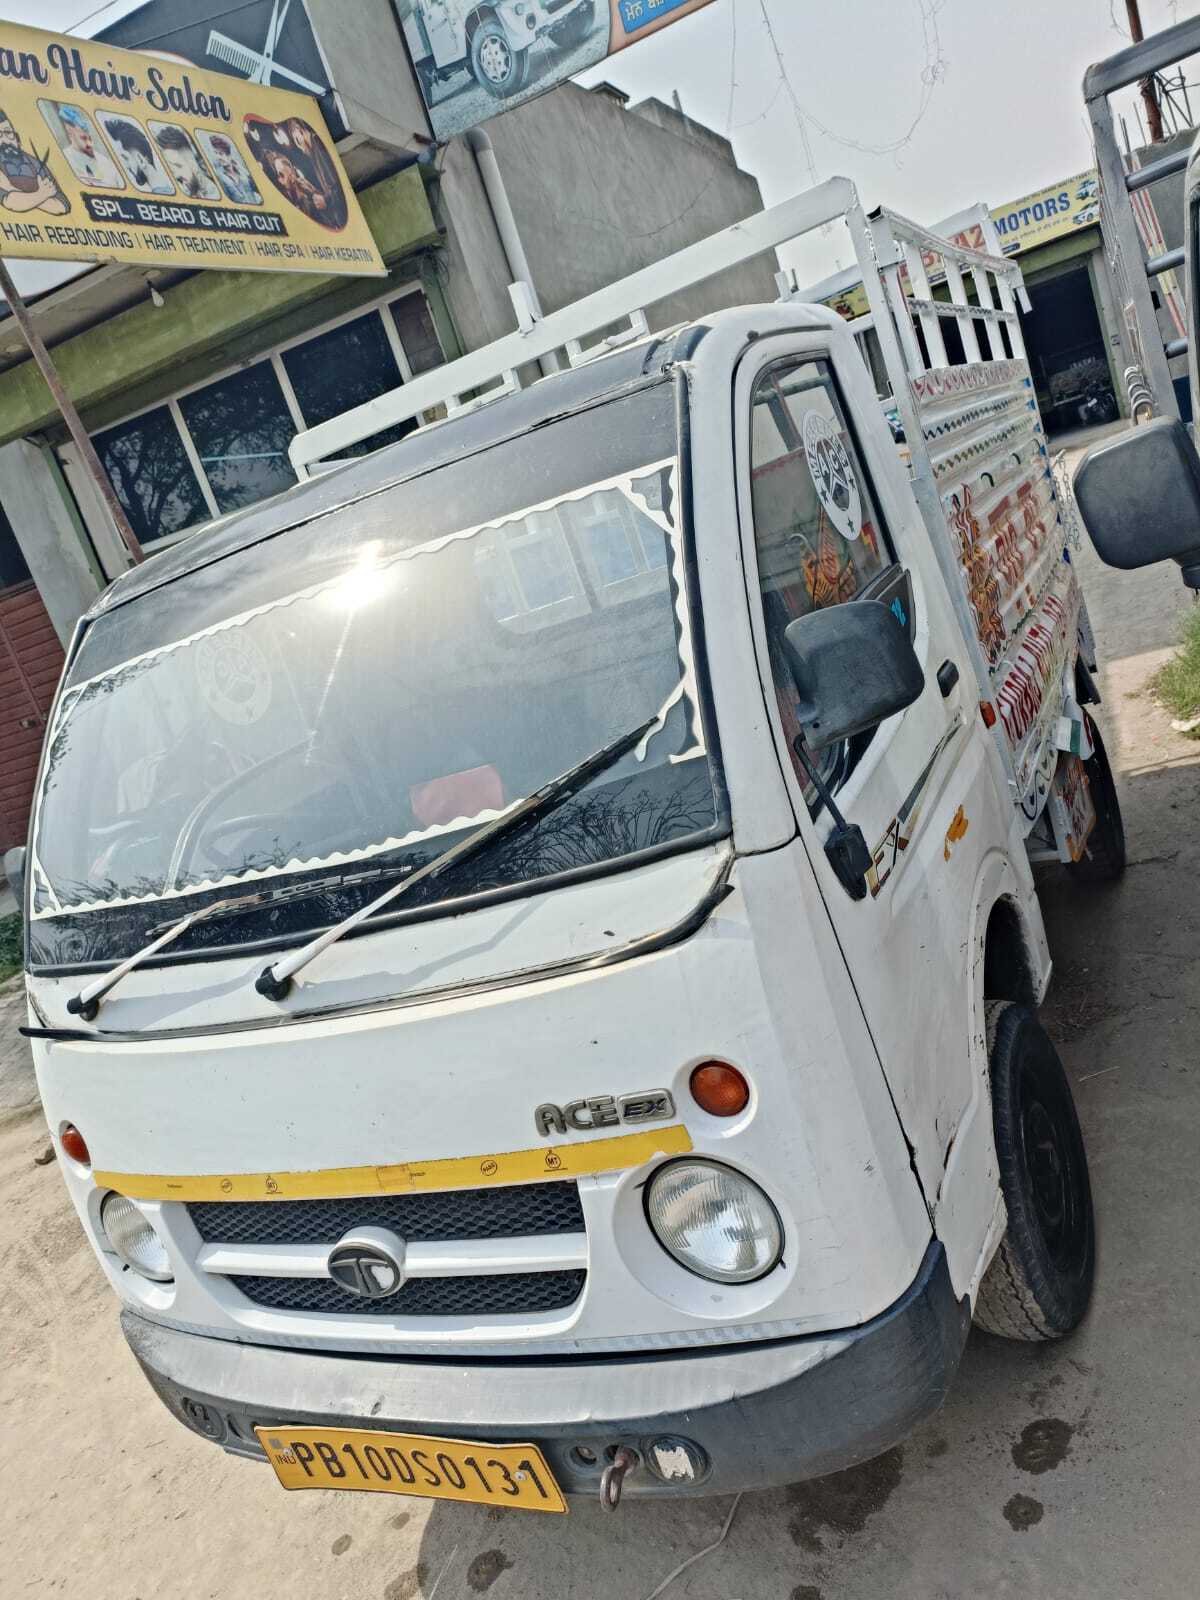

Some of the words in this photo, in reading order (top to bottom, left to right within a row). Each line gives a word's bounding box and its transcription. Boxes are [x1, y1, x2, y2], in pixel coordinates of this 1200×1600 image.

[47, 43, 141, 101] Hair
[146, 67, 231, 122] Salon
[91, 198, 134, 219] SPL.
[136, 203, 196, 225] BEARD
[199, 209, 212, 226] &
[213, 211, 252, 230] HAIR
[252, 214, 281, 233] CUT
[1, 222, 44, 243] HAIR
[44, 225, 134, 248] REBONDING
[143, 234, 174, 251] HAIR
[175, 235, 248, 256] TREATMENT
[255, 242, 282, 256] HAIR
[281, 243, 306, 259] SPA
[310, 246, 336, 260] HAIR
[534, 1094, 620, 1138] ACE
[620, 1094, 672, 1120] EX
[276, 1454, 297, 1466] IND
[290, 1441, 548, 1499] PB10DS0131
